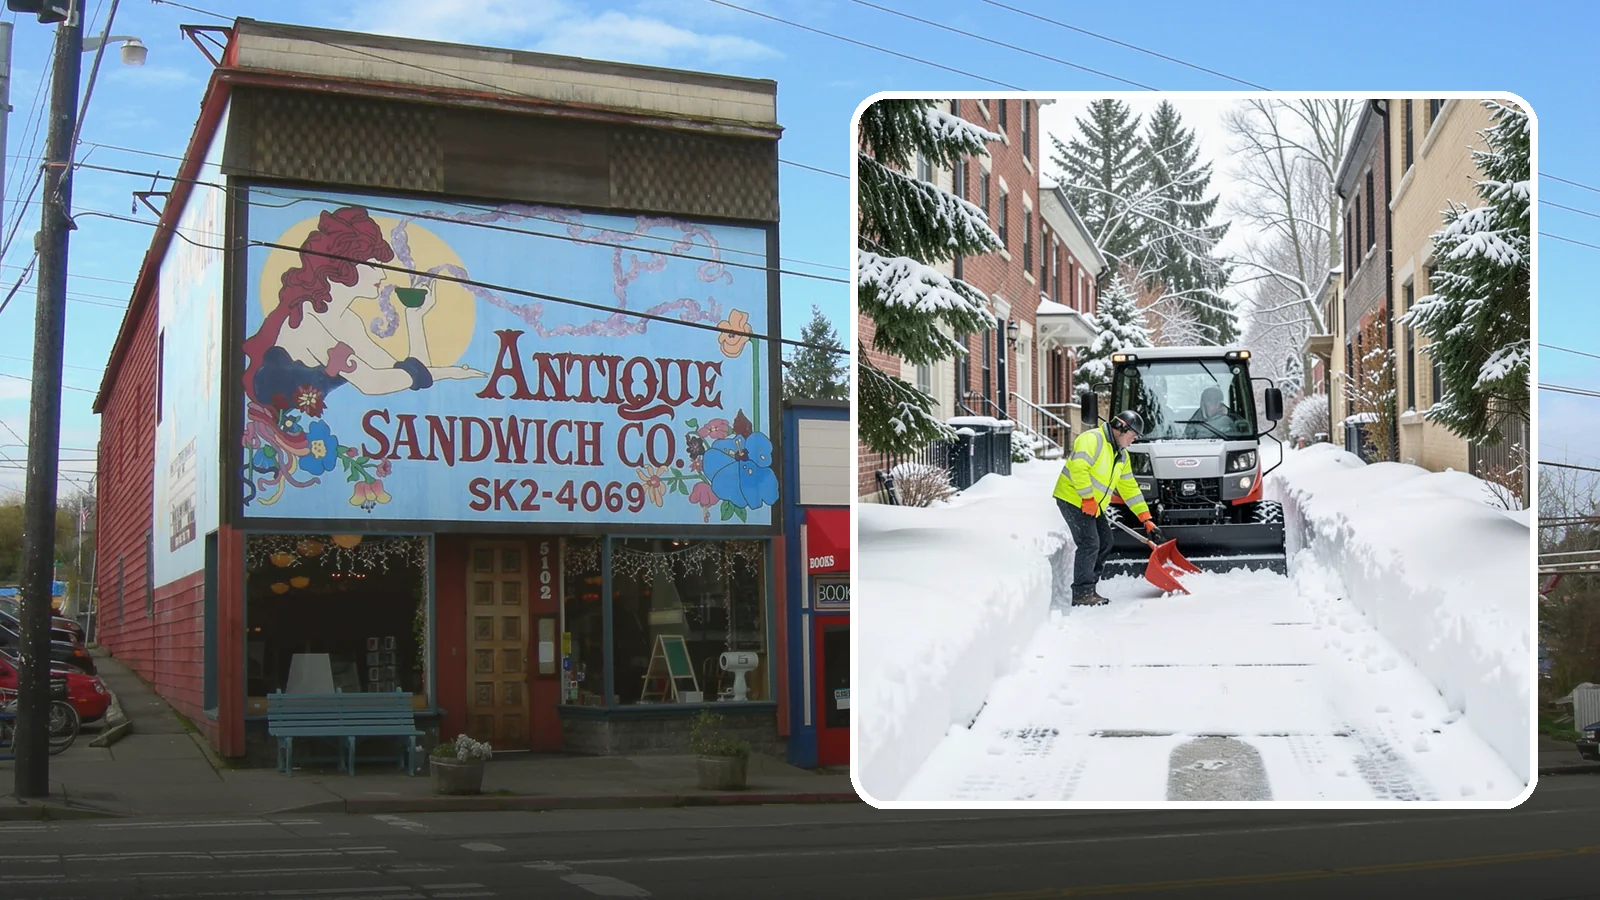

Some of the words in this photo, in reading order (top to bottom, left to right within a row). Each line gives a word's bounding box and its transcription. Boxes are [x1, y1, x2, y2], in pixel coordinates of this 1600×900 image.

[475, 329, 723, 421] ANTIQUE
[361, 408, 604, 467] SANDWICH
[617, 422, 684, 469] CO.
[468, 477, 645, 513] SK2-4069
[540, 542, 552, 599] 5102
[810, 555, 835, 568] BOOKS
